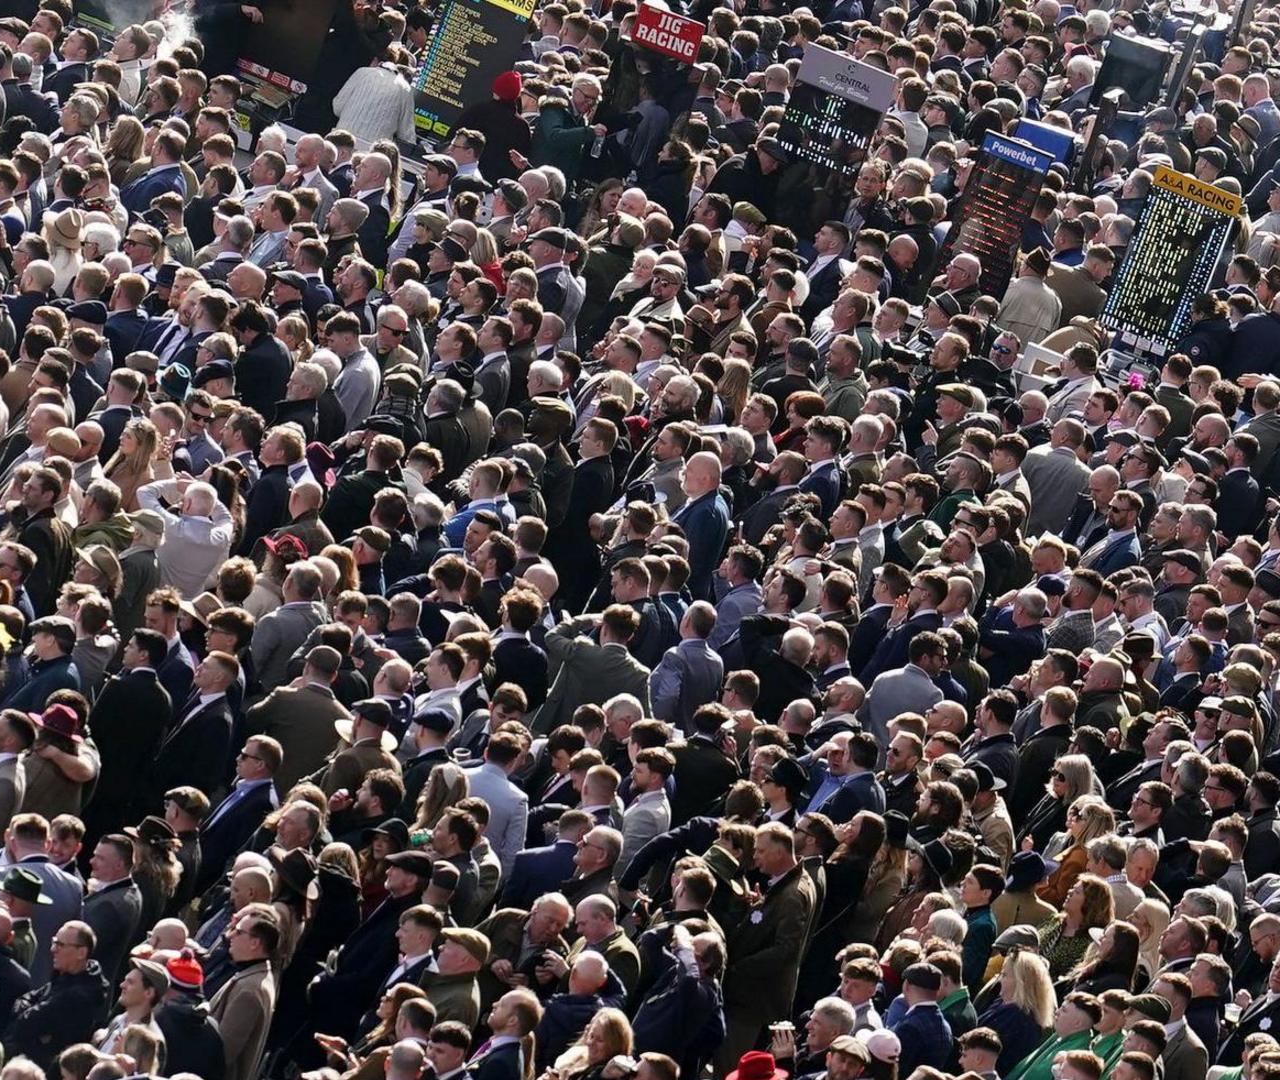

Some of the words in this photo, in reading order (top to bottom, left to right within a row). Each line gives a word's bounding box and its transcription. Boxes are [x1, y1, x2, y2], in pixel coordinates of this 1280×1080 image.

[658, 13, 682, 34] JIG
[636, 23, 695, 56] RACING
[834, 73, 871, 93] CENTRAL
[991, 141, 1037, 165] Powerbet
[1160, 173, 1183, 193] A&A
[1187, 183, 1236, 211] RACING
